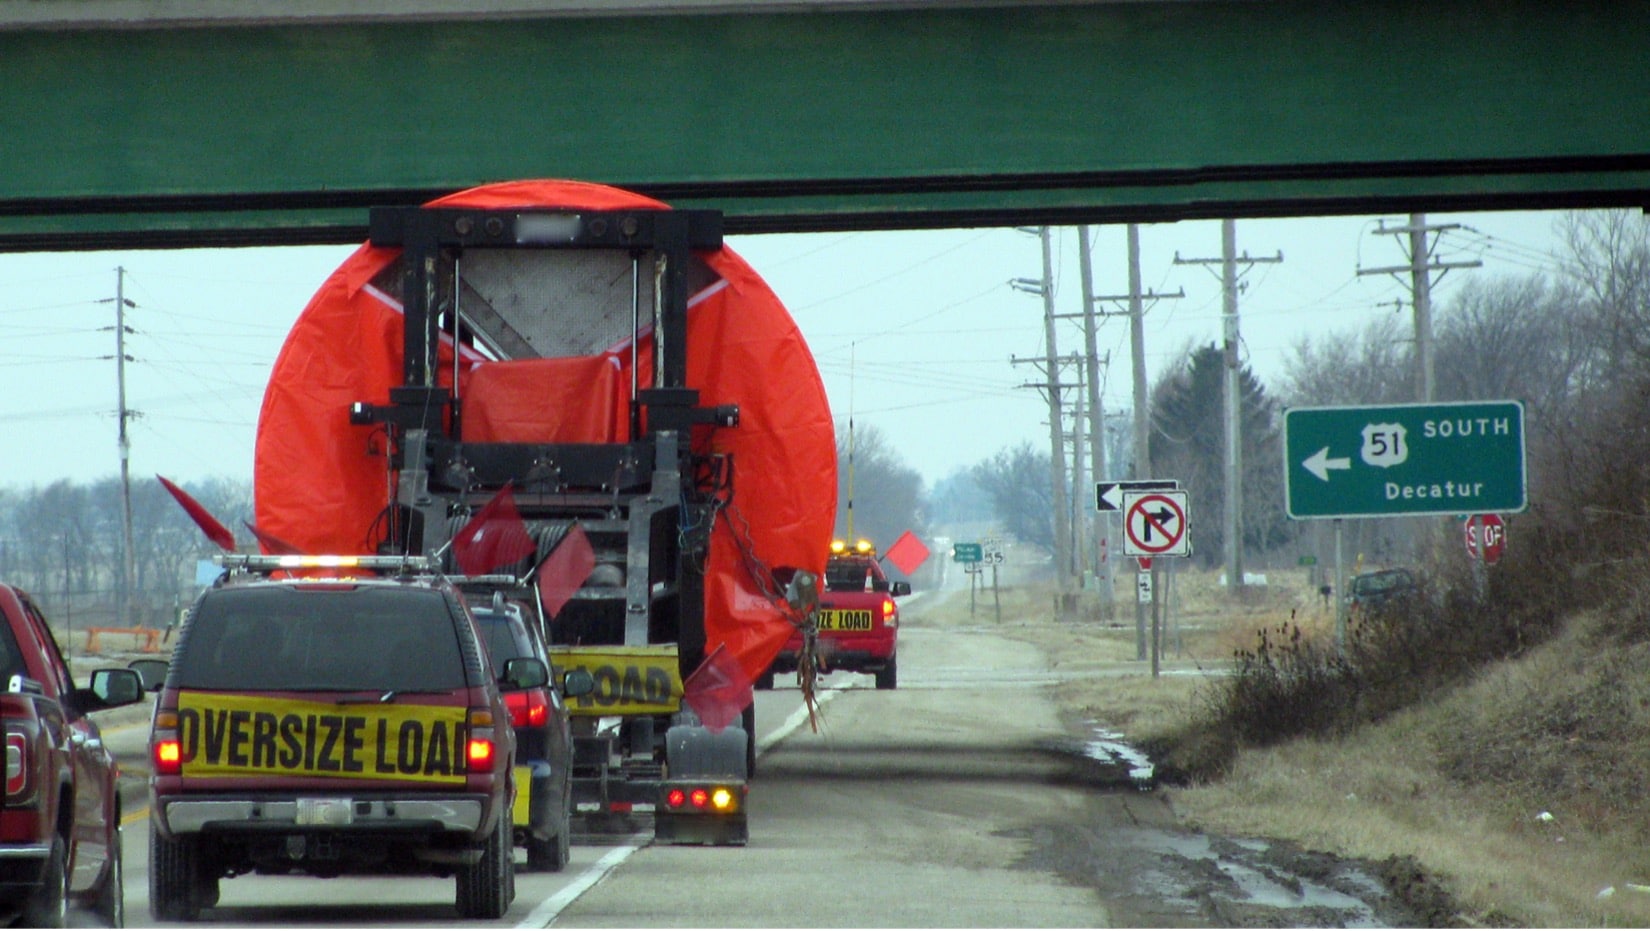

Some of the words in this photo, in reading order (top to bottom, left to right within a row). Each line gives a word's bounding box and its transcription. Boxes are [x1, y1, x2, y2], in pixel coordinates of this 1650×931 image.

[1423, 418, 1509, 438] SOUTH
[1371, 432, 1399, 457] 51
[1385, 481, 1483, 500] Decatur
[1469, 525, 1502, 547] SOP
[838, 611, 871, 629] LOAD
[178, 707, 367, 773] OVERSIZE
